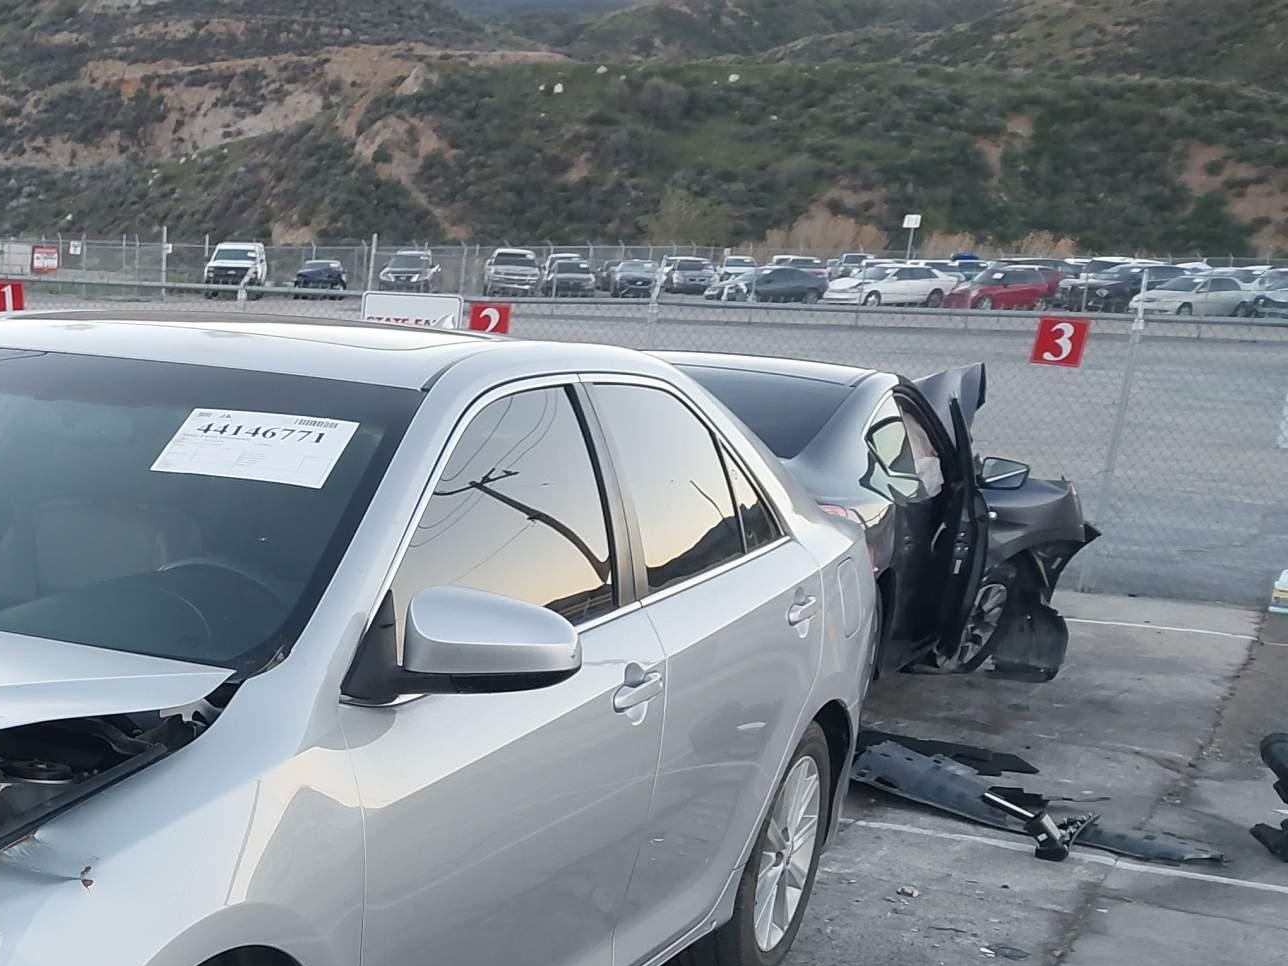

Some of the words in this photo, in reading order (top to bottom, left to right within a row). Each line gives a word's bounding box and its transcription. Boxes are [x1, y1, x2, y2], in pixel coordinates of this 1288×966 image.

[0, 284, 14, 312] 1
[479, 307, 500, 332] 2
[1042, 322, 1075, 361] 3
[197, 422, 327, 444] 44146771
